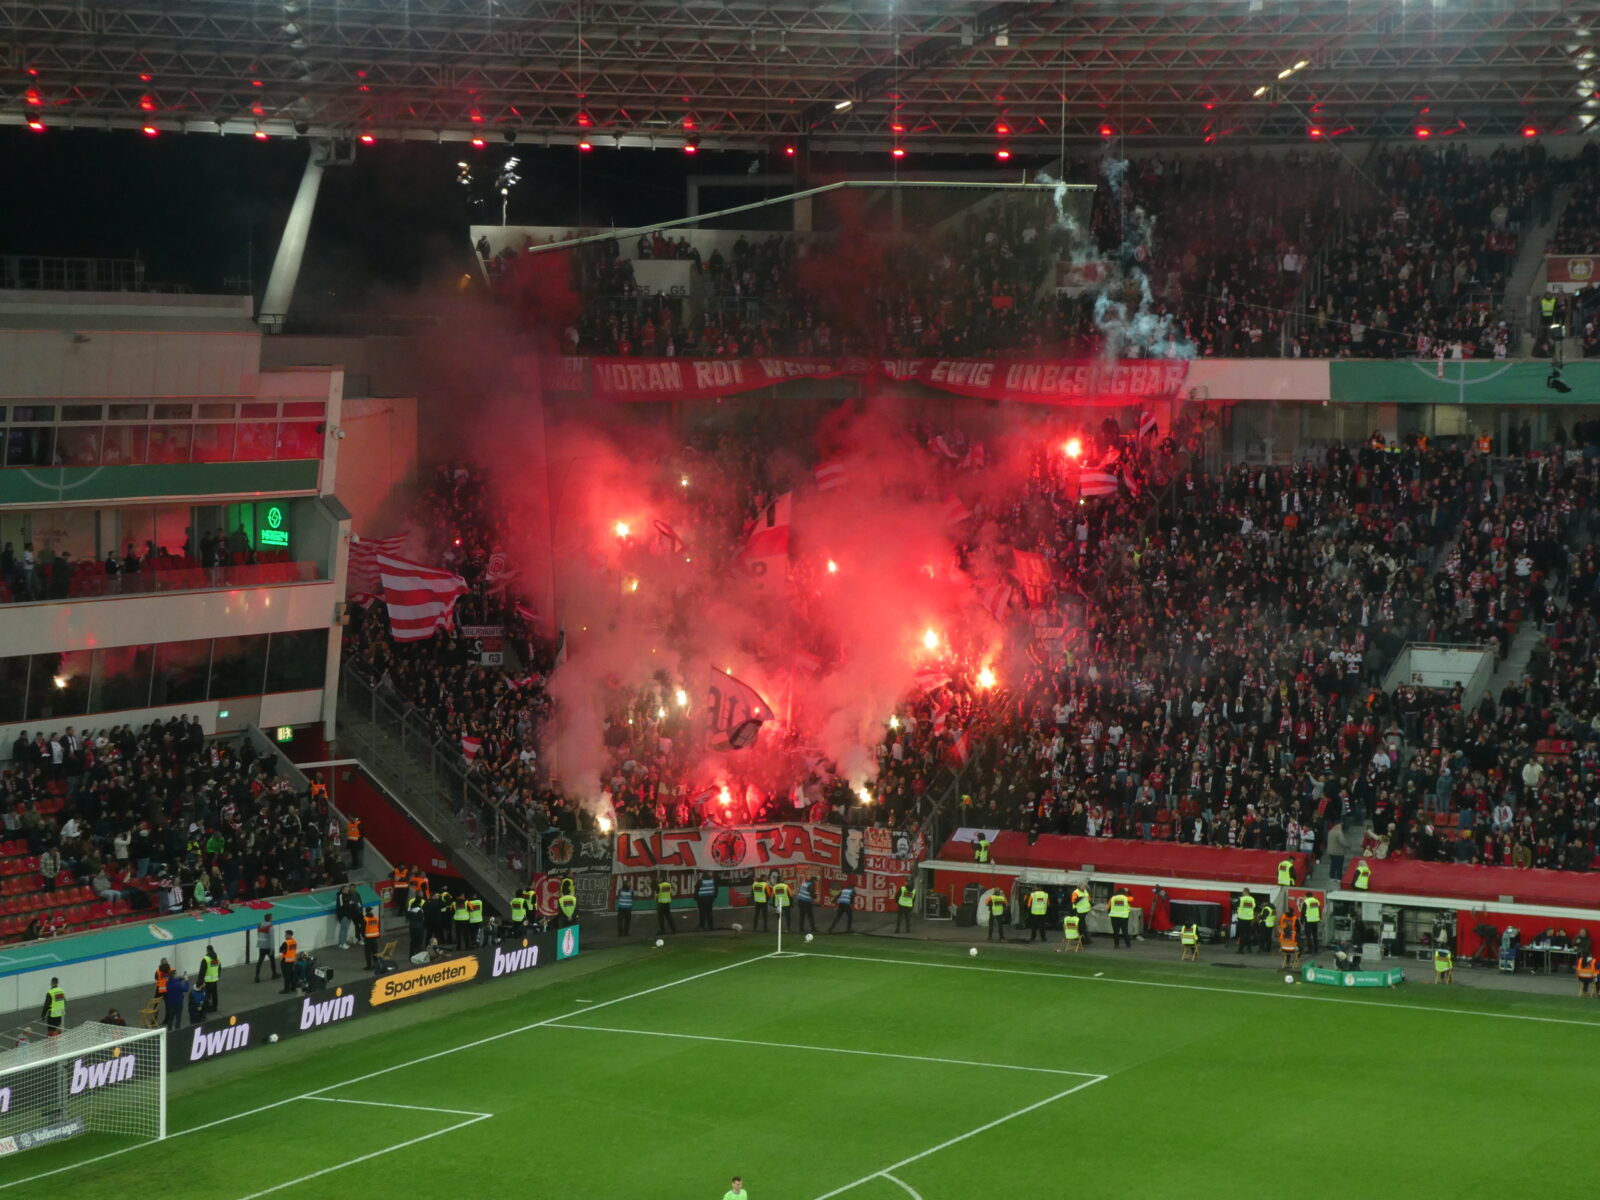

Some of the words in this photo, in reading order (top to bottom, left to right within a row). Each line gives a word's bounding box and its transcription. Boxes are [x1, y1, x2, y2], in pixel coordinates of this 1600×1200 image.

[692, 359, 744, 389] ROT
[930, 361, 995, 389] EWIG
[1005, 363, 1184, 394] UNBESIEGBAR
[492, 938, 539, 977] bwin
[384, 963, 466, 997] Sportwetten
[300, 987, 355, 1030] bwin
[190, 1015, 250, 1061] bwin
[70, 1048, 136, 1094] bwin
